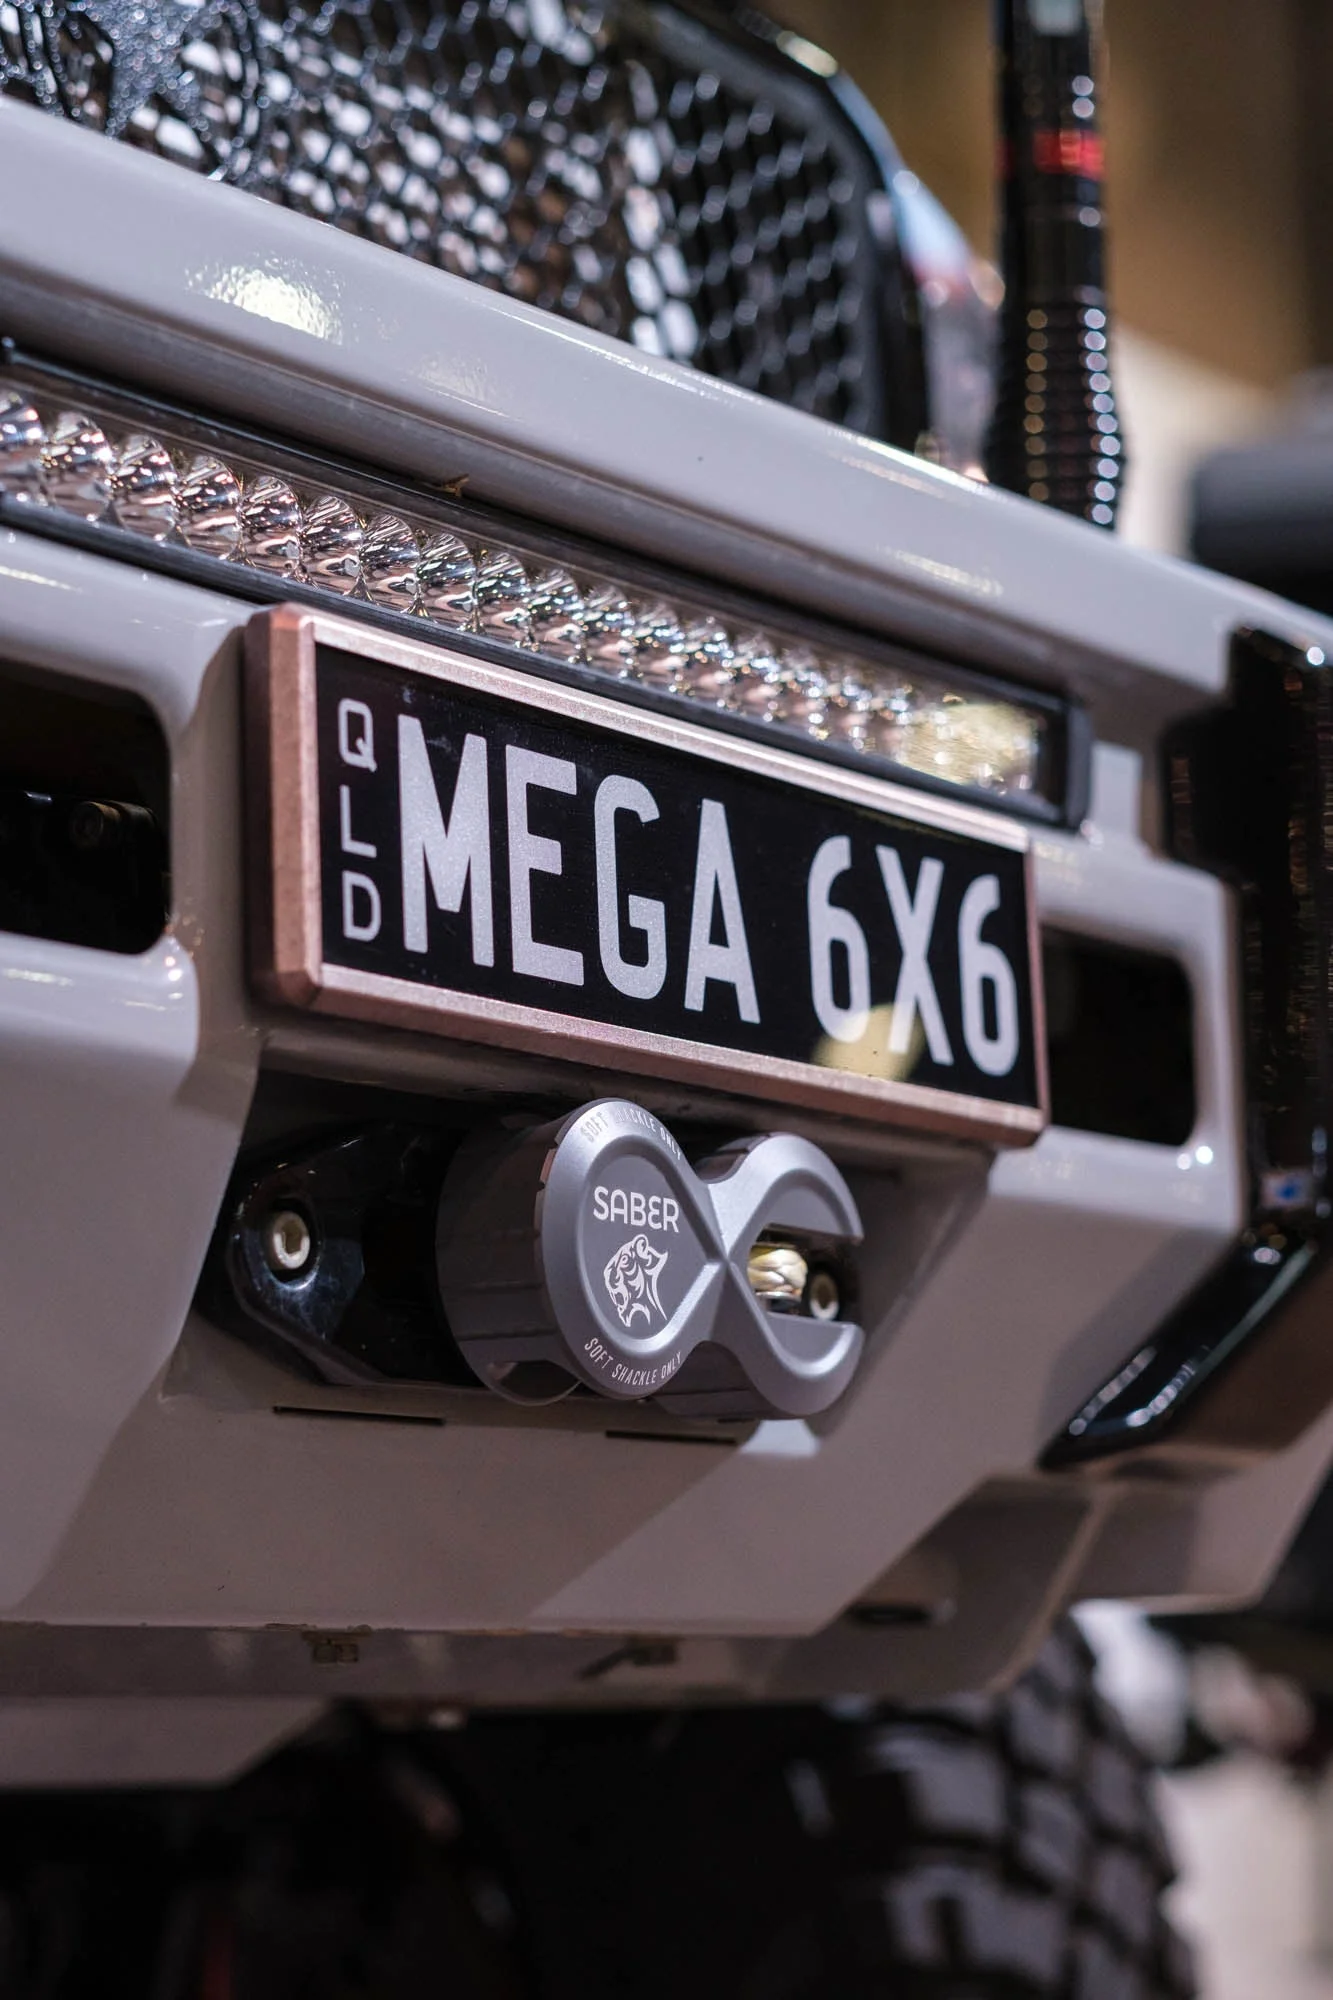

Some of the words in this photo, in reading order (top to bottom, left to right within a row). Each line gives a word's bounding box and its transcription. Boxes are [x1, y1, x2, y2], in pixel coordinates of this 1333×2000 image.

[338, 698, 381, 942] QLD
[398, 714, 761, 1024] MEGA
[808, 835, 1019, 1076] 6X6
[580, 1111, 609, 1143] SOFT
[613, 1107, 657, 1133] HACKLE
[660, 1127, 682, 1161] ONLY
[593, 1186, 680, 1233] SABER
[584, 1337, 614, 1370] SOFT
[611, 1363, 658, 1386] SHACKLE
[661, 1351, 682, 1380] ONLY
